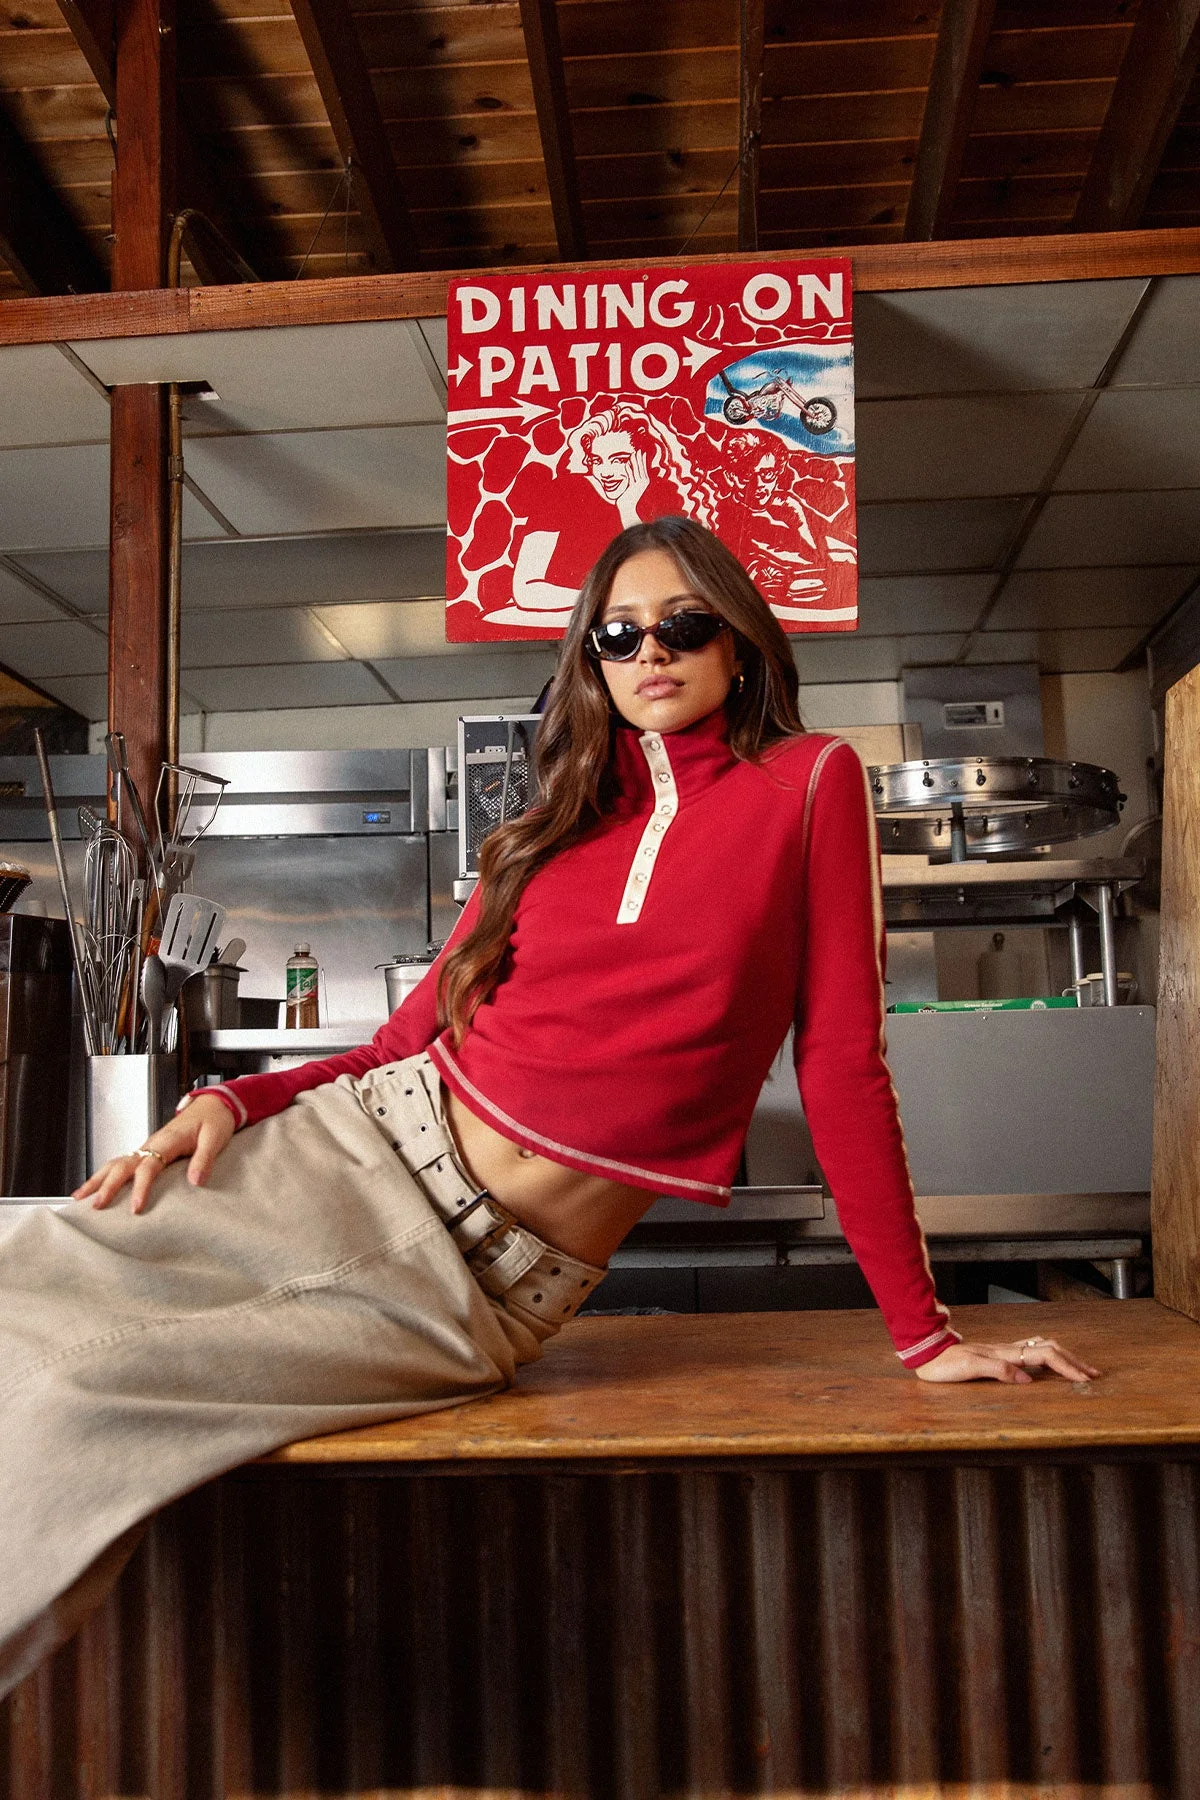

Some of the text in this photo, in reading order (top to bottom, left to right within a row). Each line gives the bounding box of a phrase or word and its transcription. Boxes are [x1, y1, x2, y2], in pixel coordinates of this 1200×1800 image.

[456, 272, 844, 334] DINING ON
[478, 341, 680, 398] PATIO
